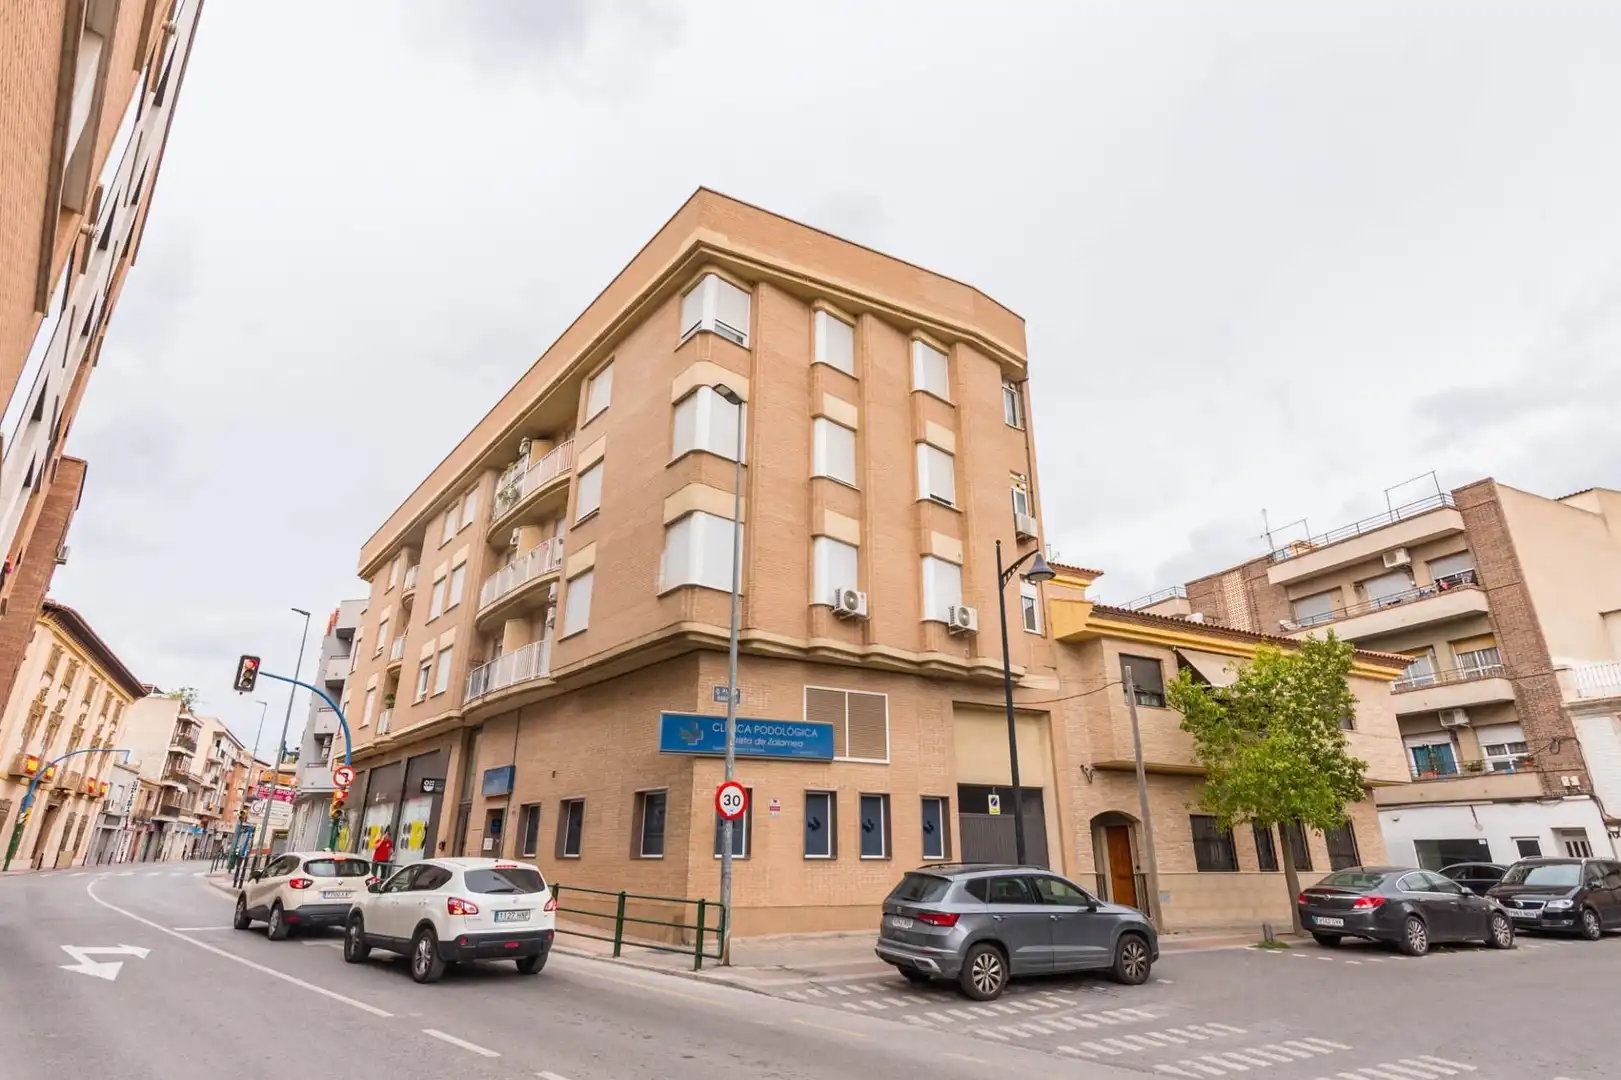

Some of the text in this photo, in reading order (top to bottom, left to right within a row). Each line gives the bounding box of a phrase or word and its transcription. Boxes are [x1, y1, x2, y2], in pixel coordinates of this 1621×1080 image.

[754, 724, 818, 738] PODOLÓGICA
[754, 736, 766, 745] de
[723, 794, 741, 807] 30
